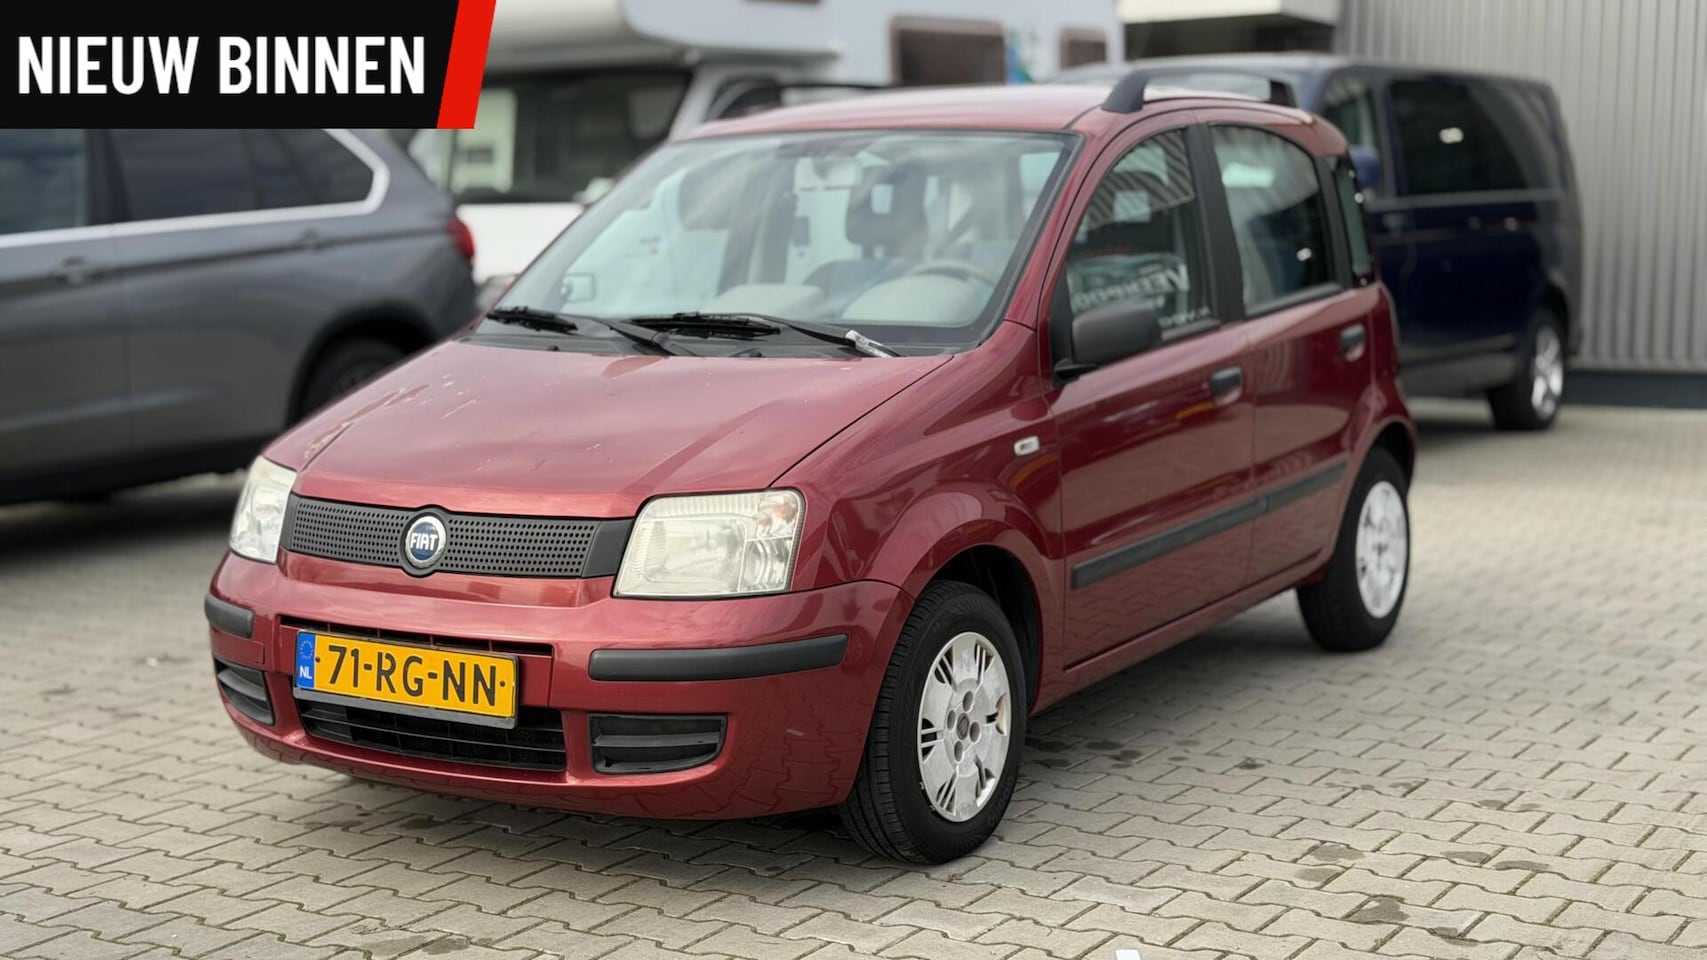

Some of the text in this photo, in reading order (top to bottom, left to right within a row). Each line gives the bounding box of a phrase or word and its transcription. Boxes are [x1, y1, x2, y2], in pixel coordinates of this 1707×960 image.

[410, 532, 438, 550] FIAT
[300, 666, 312, 679] NL
[328, 645, 496, 706] 71-RG-NN
